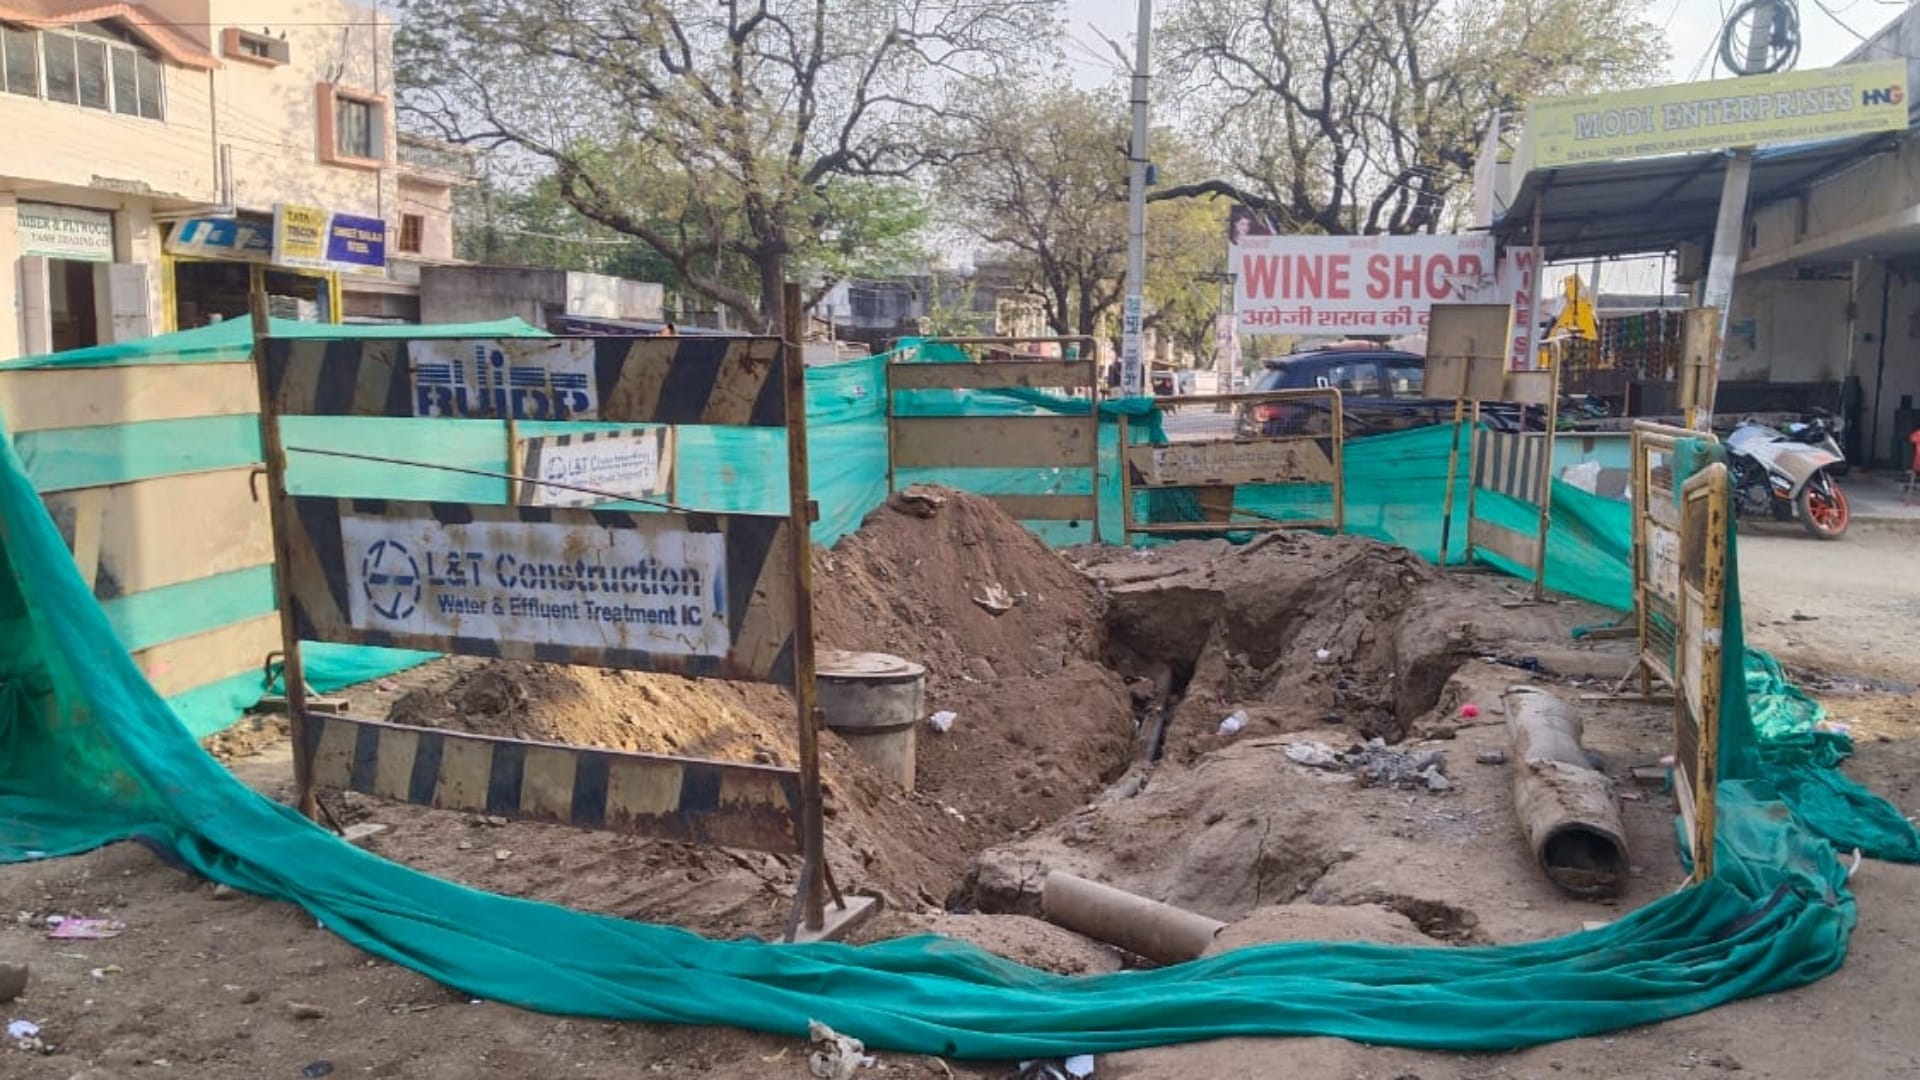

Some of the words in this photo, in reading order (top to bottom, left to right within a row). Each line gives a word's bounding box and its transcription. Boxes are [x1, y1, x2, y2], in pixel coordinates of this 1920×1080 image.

[1862, 84, 1904, 106] HNG
[1574, 104, 1654, 140] MODI
[1662, 85, 1855, 132] ENTERPRISES
[287, 210, 309, 223] TATA
[1242, 253, 1351, 300] WINE
[1317, 309, 1376, 327] शराब
[1382, 305, 1412, 327] की
[426, 550, 484, 588] L&T
[498, 552, 702, 597] Construction
[437, 593, 488, 615] Water
[492, 597, 502, 616] &
[510, 599, 580, 621] Effluent
[584, 600, 678, 626] Treatment
[681, 604, 702, 627] IC
